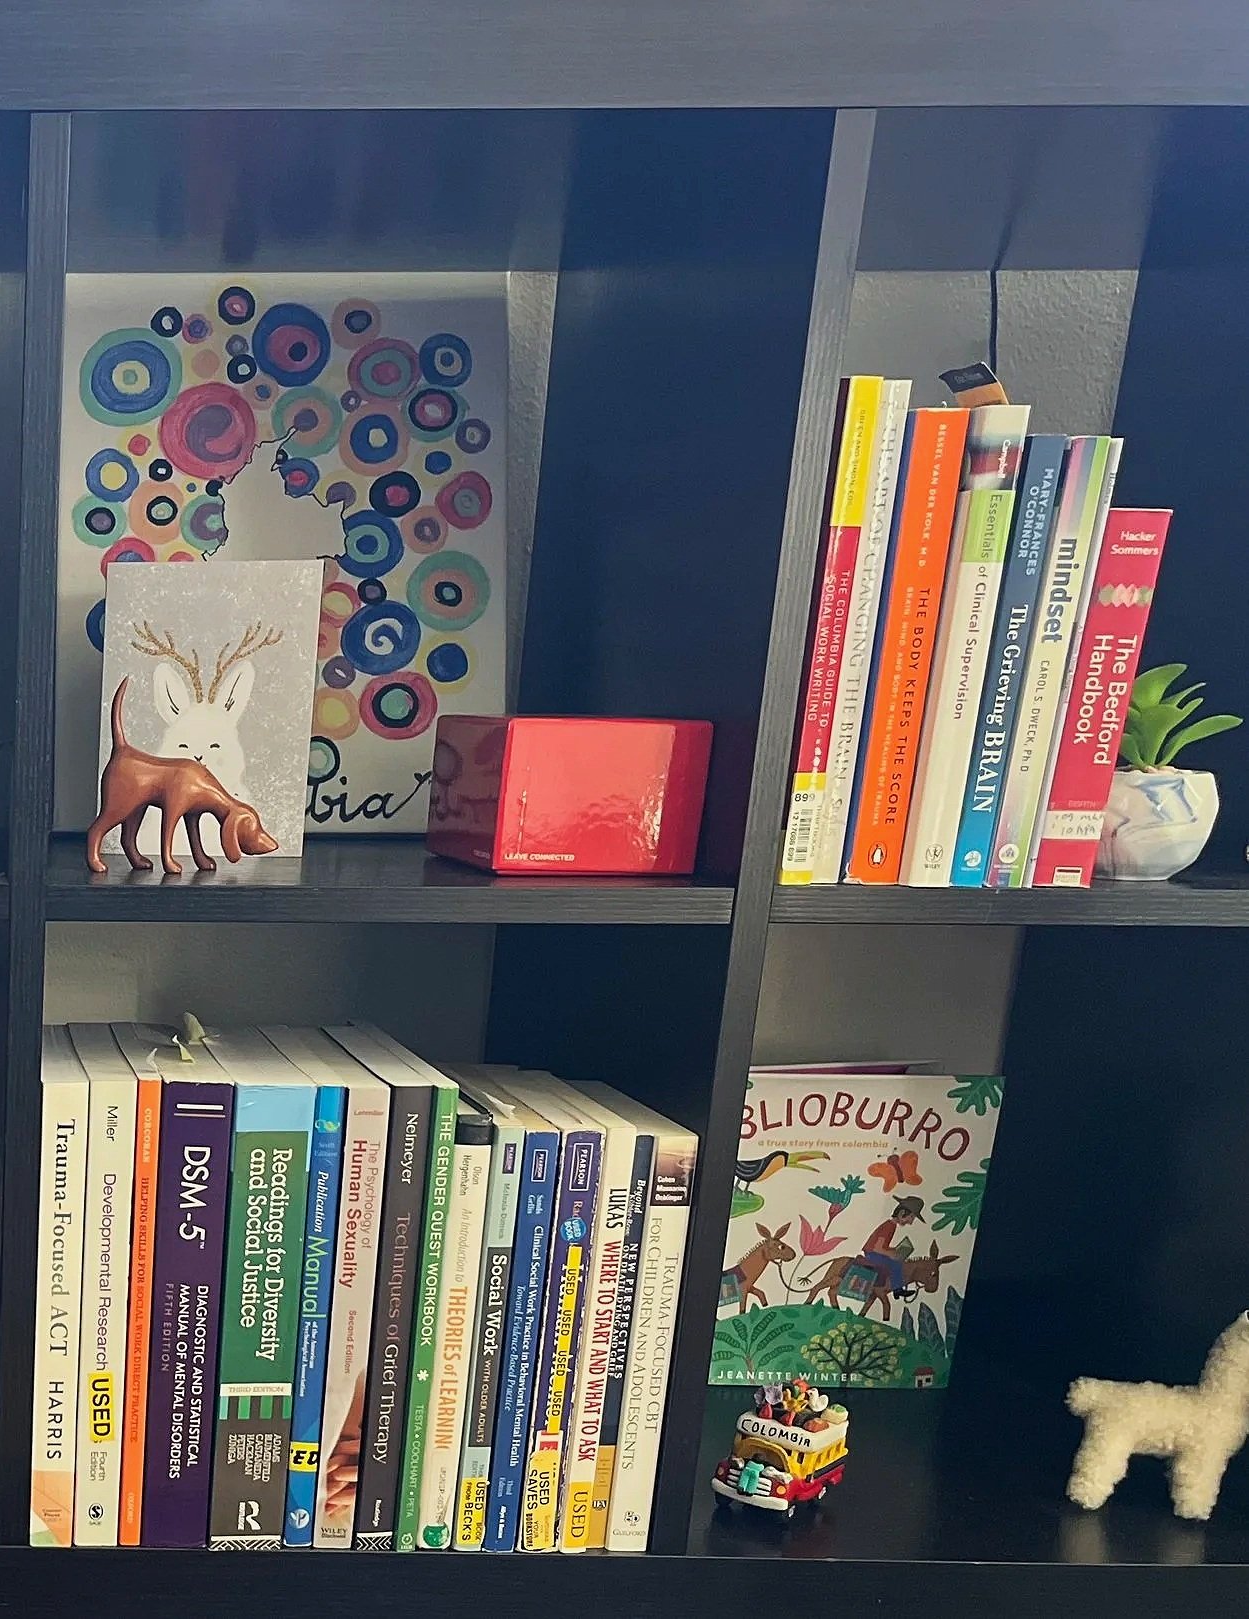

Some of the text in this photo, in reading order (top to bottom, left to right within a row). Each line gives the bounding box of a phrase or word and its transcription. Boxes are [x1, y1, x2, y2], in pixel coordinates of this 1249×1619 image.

[1017, 486, 1040, 559] O'CONNOR
[1025, 468, 1054, 577] MARY-FRANCES
[1110, 544, 1159, 556] Sommers
[1121, 531, 1157, 542] Hacker
[954, 495, 1004, 721] Essentials of Clinical Supervision
[1041, 538, 1080, 644] mindset
[818, 571, 851, 729] THE COLUMBIA GUIDE TO
[1034, 660, 1051, 693] CAROL
[971, 604, 1029, 813] The Grieving BRAIN
[1072, 634, 1113, 745] Handbook
[1092, 634, 1138, 765] The Bedford
[1023, 709, 1041, 746] DWECK,
[794, 792, 816, 803] 899
[105, 1105, 120, 1142] Miller
[141, 1108, 153, 1164] CORCORAN
[179, 1145, 212, 1242] DSM-5
[360, 1142, 382, 1250] The Psychology of
[459, 1154, 472, 1197] Hergenhahn
[472, 1166, 483, 1185] Olson
[576, 1148, 589, 1186] PEARSON
[634, 1179, 647, 1214] Beyond
[48, 1119, 77, 1357] Trauma-Focused ACT
[239, 1147, 269, 1329] and Social Justice
[255, 1147, 294, 1361] Readings for Diversity
[420, 1112, 454, 1347] THE GENDER QUEST WORKBOOK
[95, 1173, 118, 1371] Developmental Research
[160, 1283, 175, 1373] FIFTH EDITION
[343, 1310, 357, 1374] Second Edition
[551, 1268, 577, 1417] USED USED USED USED
[613, 1242, 639, 1379] NEW PERSPECTIVES
[168, 1284, 191, 1480] MANUAL OF MENTAL DISORDERS
[186, 1285, 210, 1467] DIAGNOSTIC AND STATISTICAL
[476, 1254, 508, 1443] Social Work WITH OLDER ADULTS
[717, 1369, 859, 1382] JEANETTE WINTER
[46, 1381, 66, 1460] HARRIS
[91, 1377, 112, 1438] USED
[740, 1418, 812, 1448] COLOMBIA
[88, 1450, 99, 1481] Edition
[98, 1450, 109, 1481] Fourth
[474, 1481, 485, 1511] USED
[527, 1469, 539, 1510] SAVES
[539, 1471, 551, 1505] USED
[461, 1502, 474, 1541] BECK'S
[571, 1490, 589, 1539] USED
